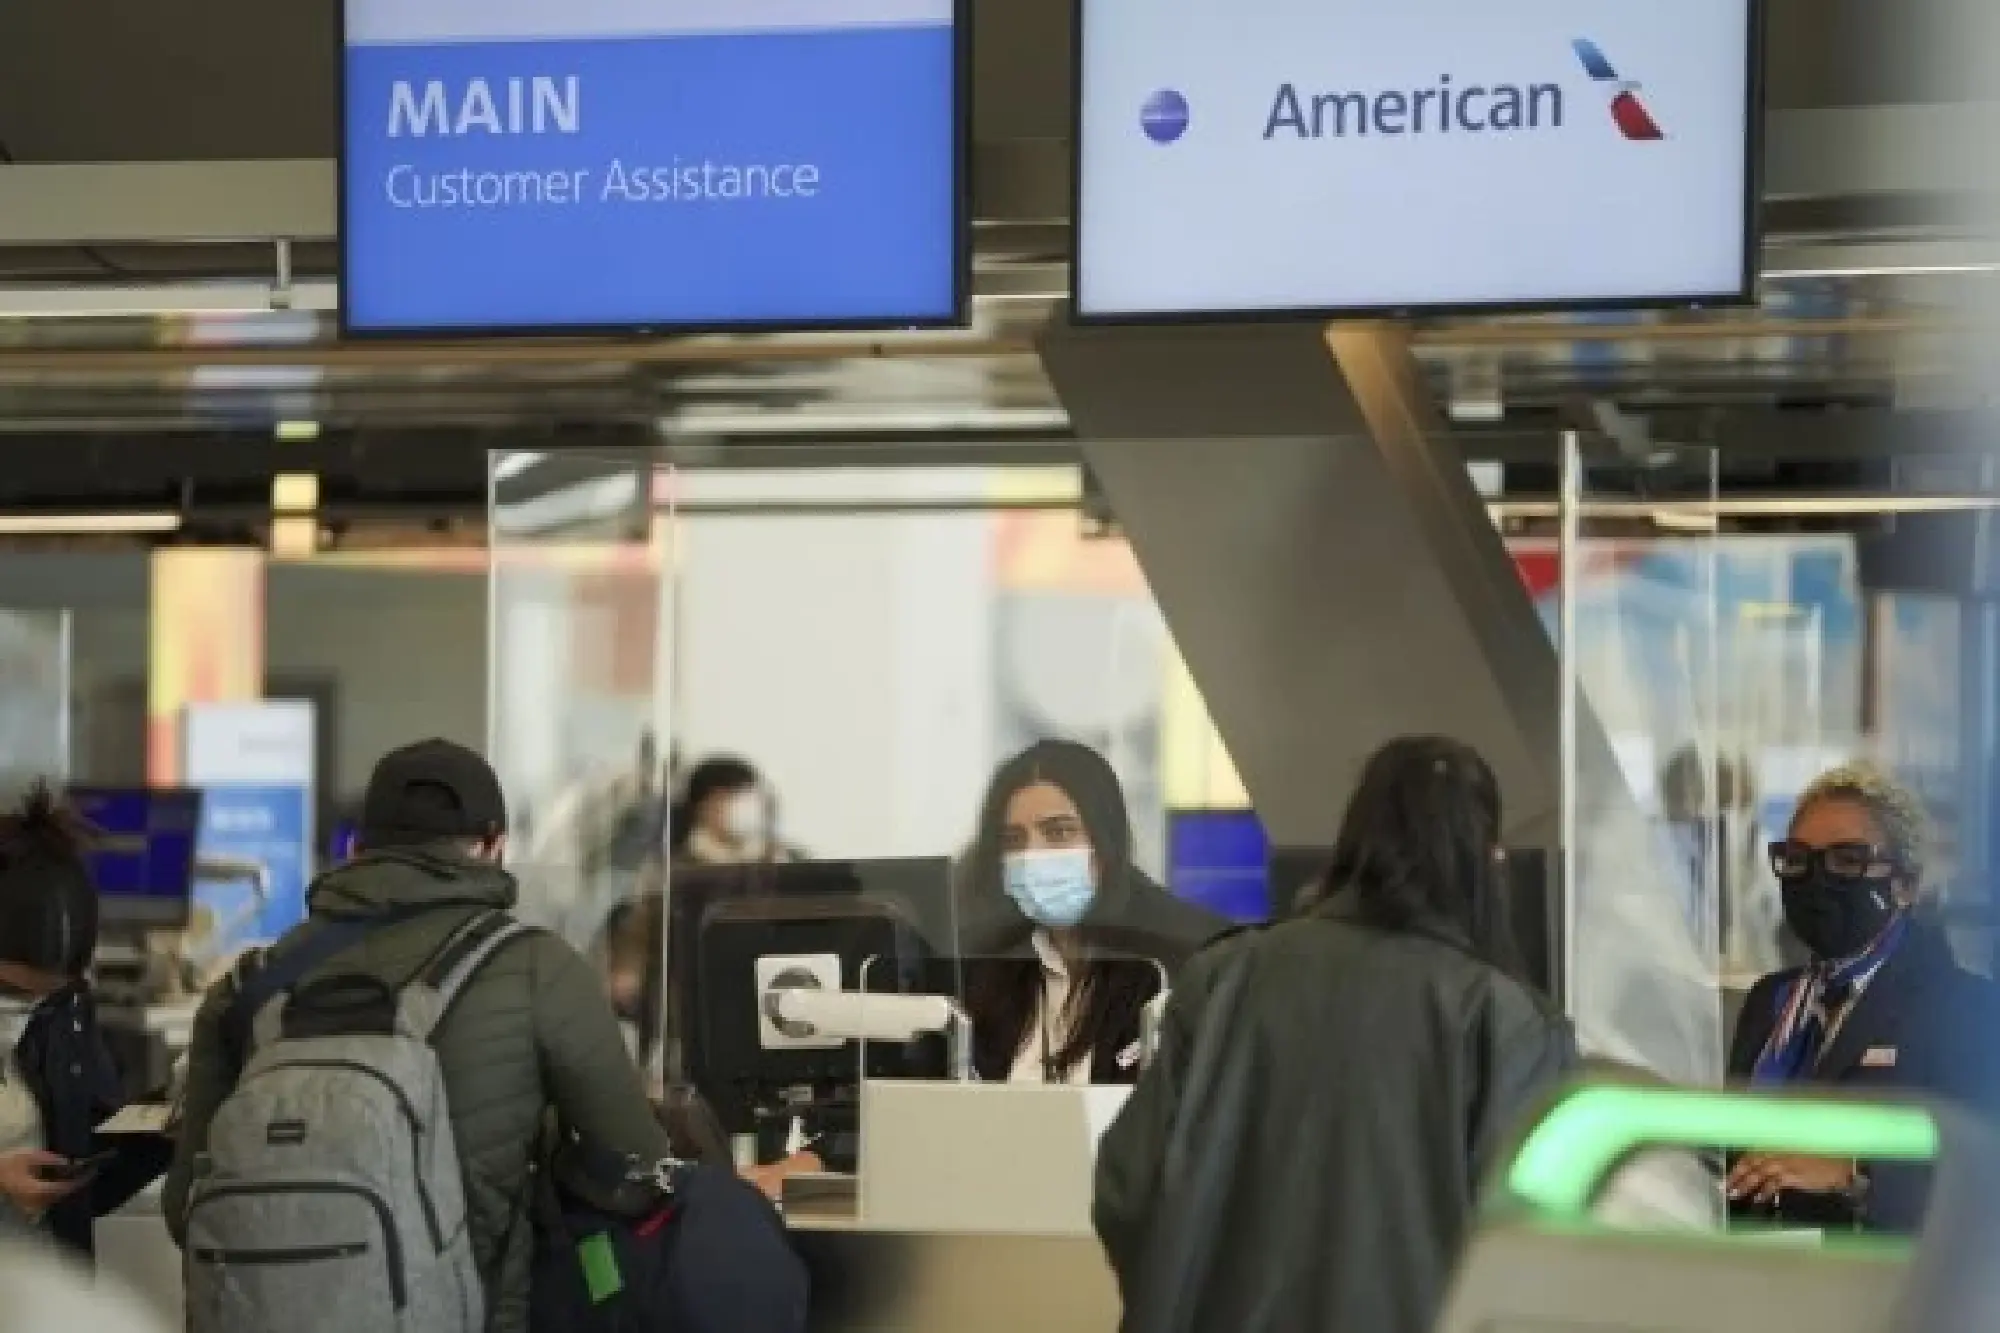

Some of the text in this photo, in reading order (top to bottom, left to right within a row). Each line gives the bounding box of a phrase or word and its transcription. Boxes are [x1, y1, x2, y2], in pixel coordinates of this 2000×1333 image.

[387, 75, 580, 138] MAIN
[1262, 73, 1564, 141] American
[385, 155, 820, 208] Customer Assistance
